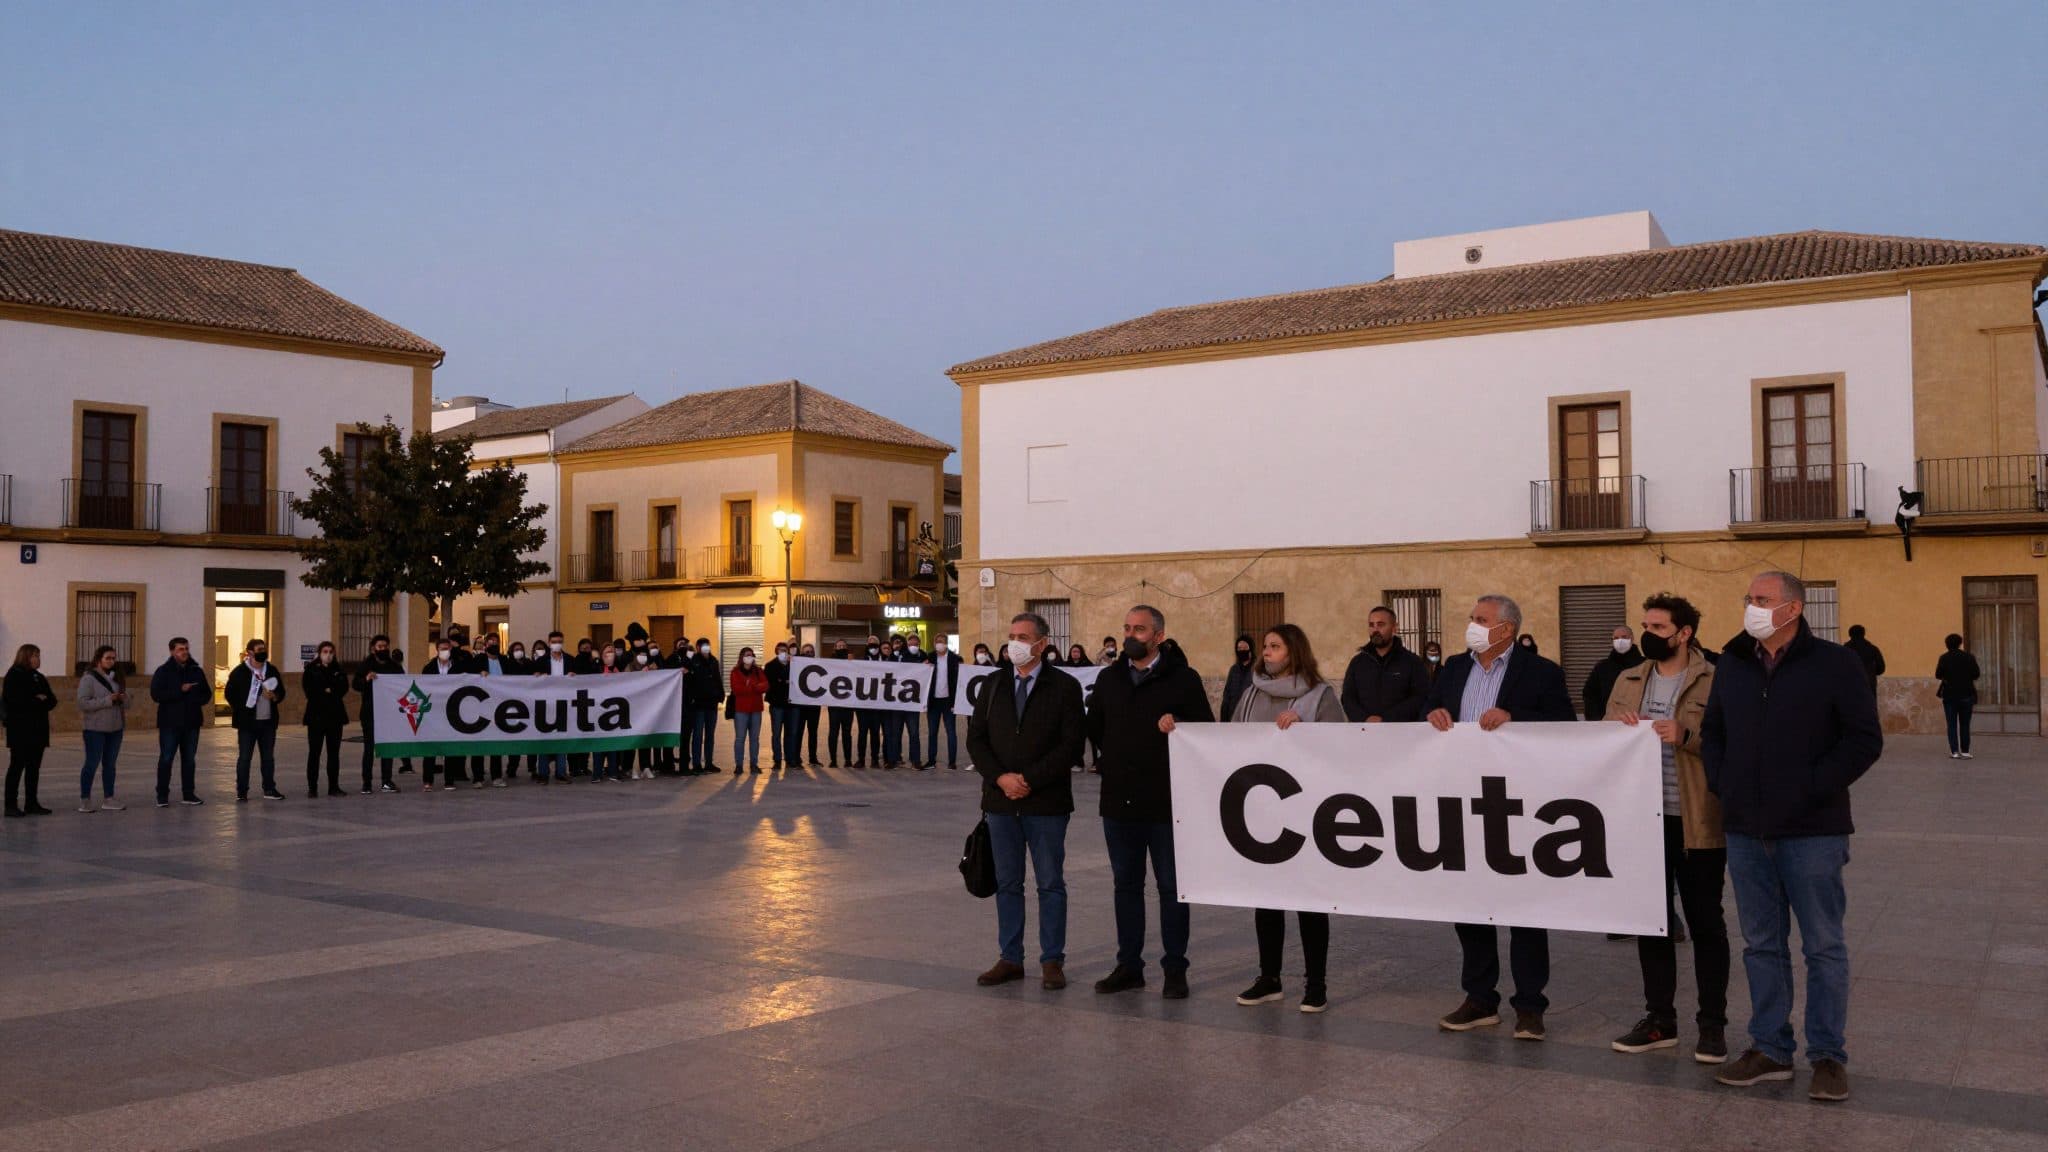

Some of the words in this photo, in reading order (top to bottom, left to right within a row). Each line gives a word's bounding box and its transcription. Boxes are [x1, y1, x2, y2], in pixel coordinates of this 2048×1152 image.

[798, 664, 921, 703] Ceuta
[445, 685, 632, 734] Ceuta
[1219, 763, 1614, 878] Ceuta
